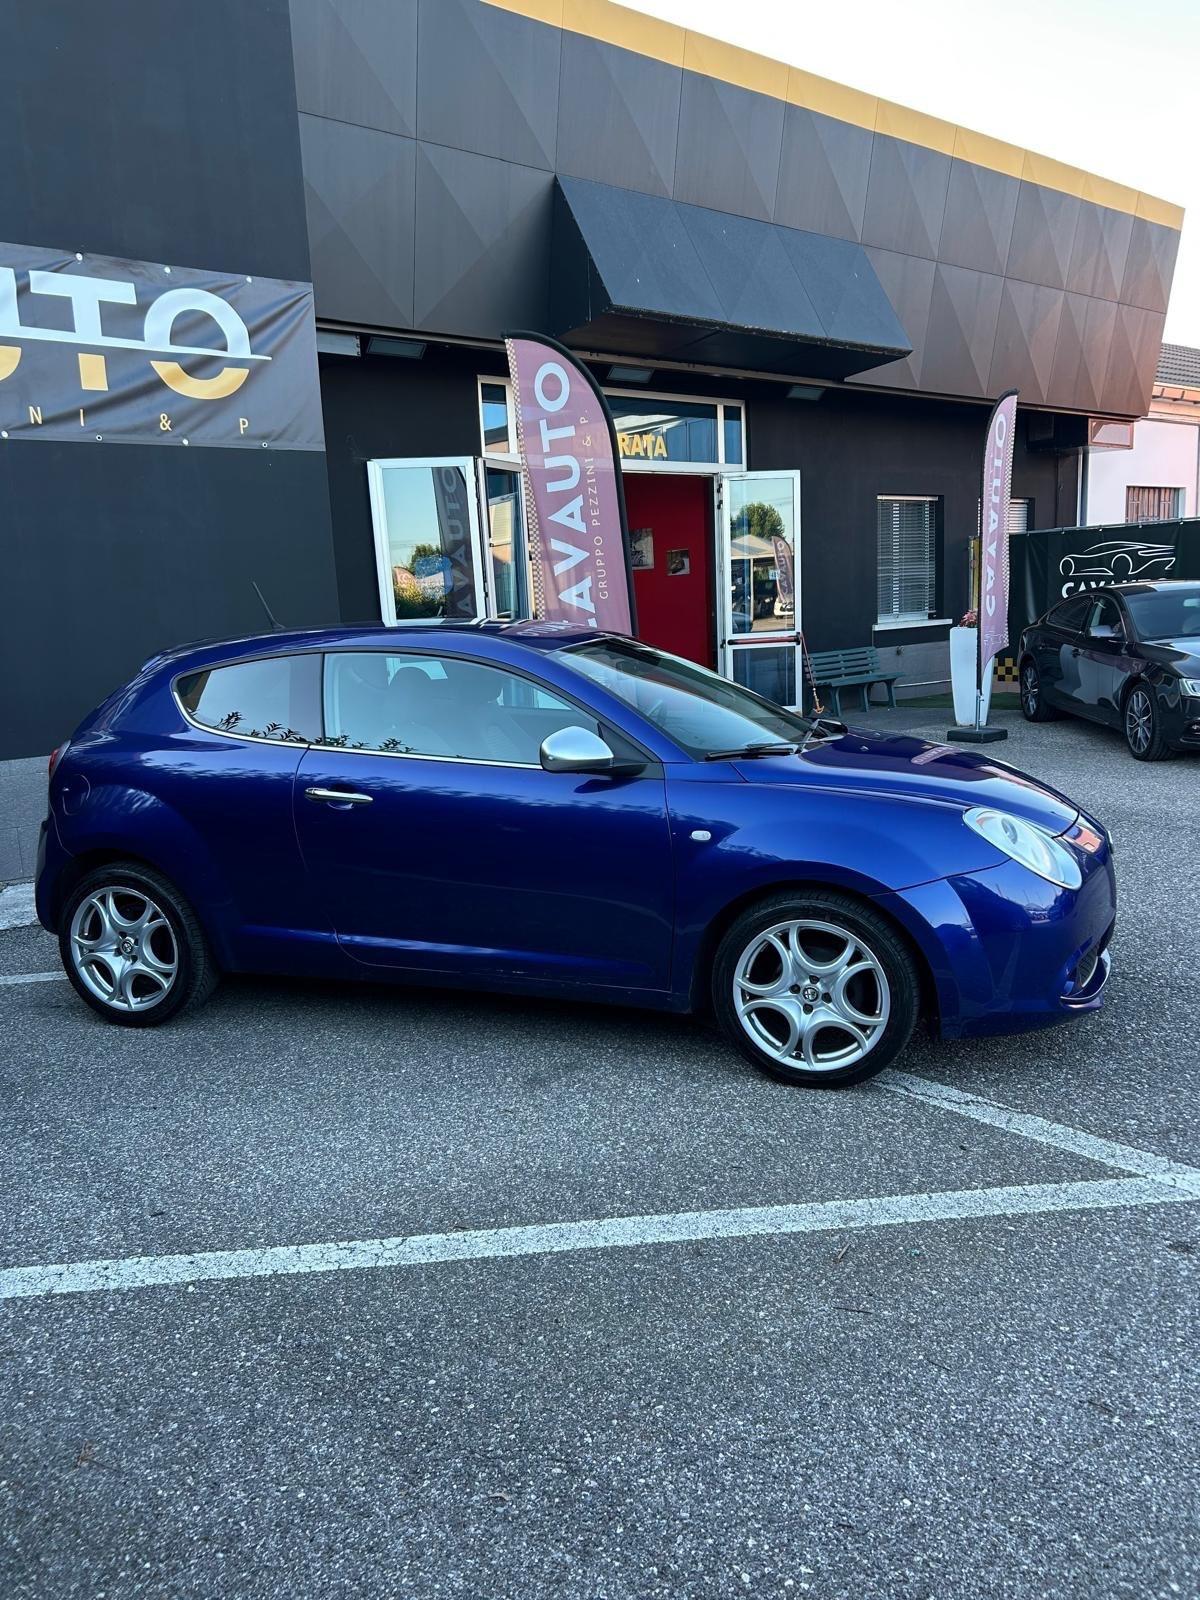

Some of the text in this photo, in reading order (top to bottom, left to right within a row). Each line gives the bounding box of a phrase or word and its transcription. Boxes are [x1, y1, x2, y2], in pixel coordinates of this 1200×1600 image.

[159, 413, 173, 432] &
[582, 435, 593, 447] &
[617, 432, 668, 459] RATA
[584, 457, 602, 527] PEZZINI
[593, 535, 609, 600] GRUPPO
